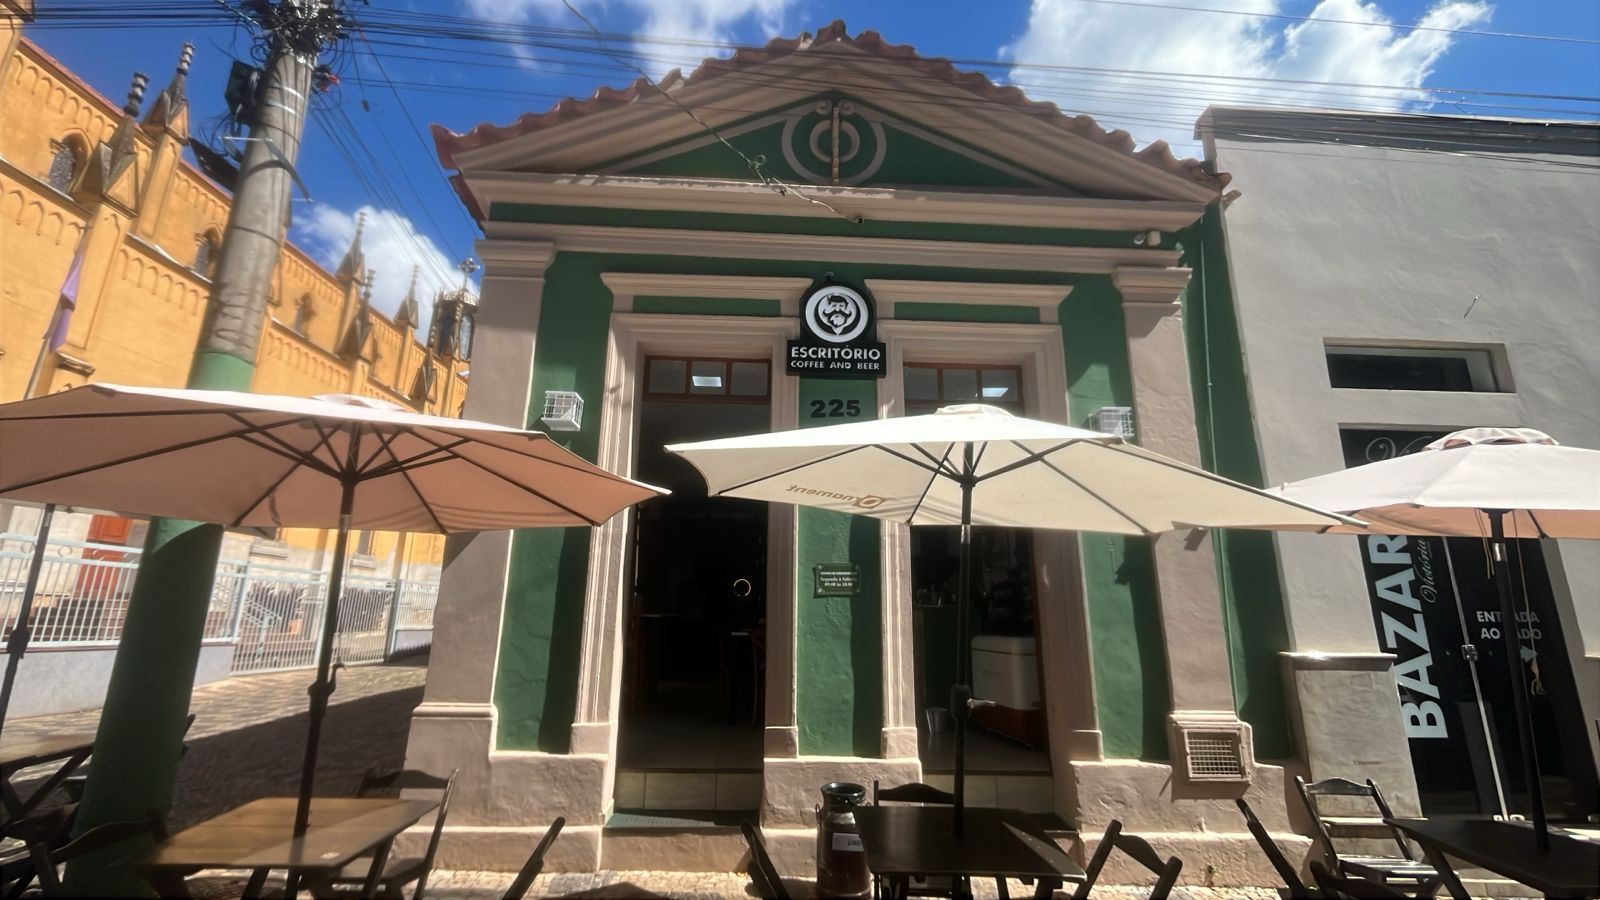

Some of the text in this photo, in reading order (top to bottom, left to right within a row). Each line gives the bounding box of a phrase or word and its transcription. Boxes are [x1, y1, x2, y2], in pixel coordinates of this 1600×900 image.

[791, 345, 881, 361] ESCRITÓRIO
[790, 360, 880, 370] COFFEE AND BEER
[810, 399, 861, 418] 225
[1367, 535, 1449, 738] BAZAR
[1481, 627, 1501, 640] AO
